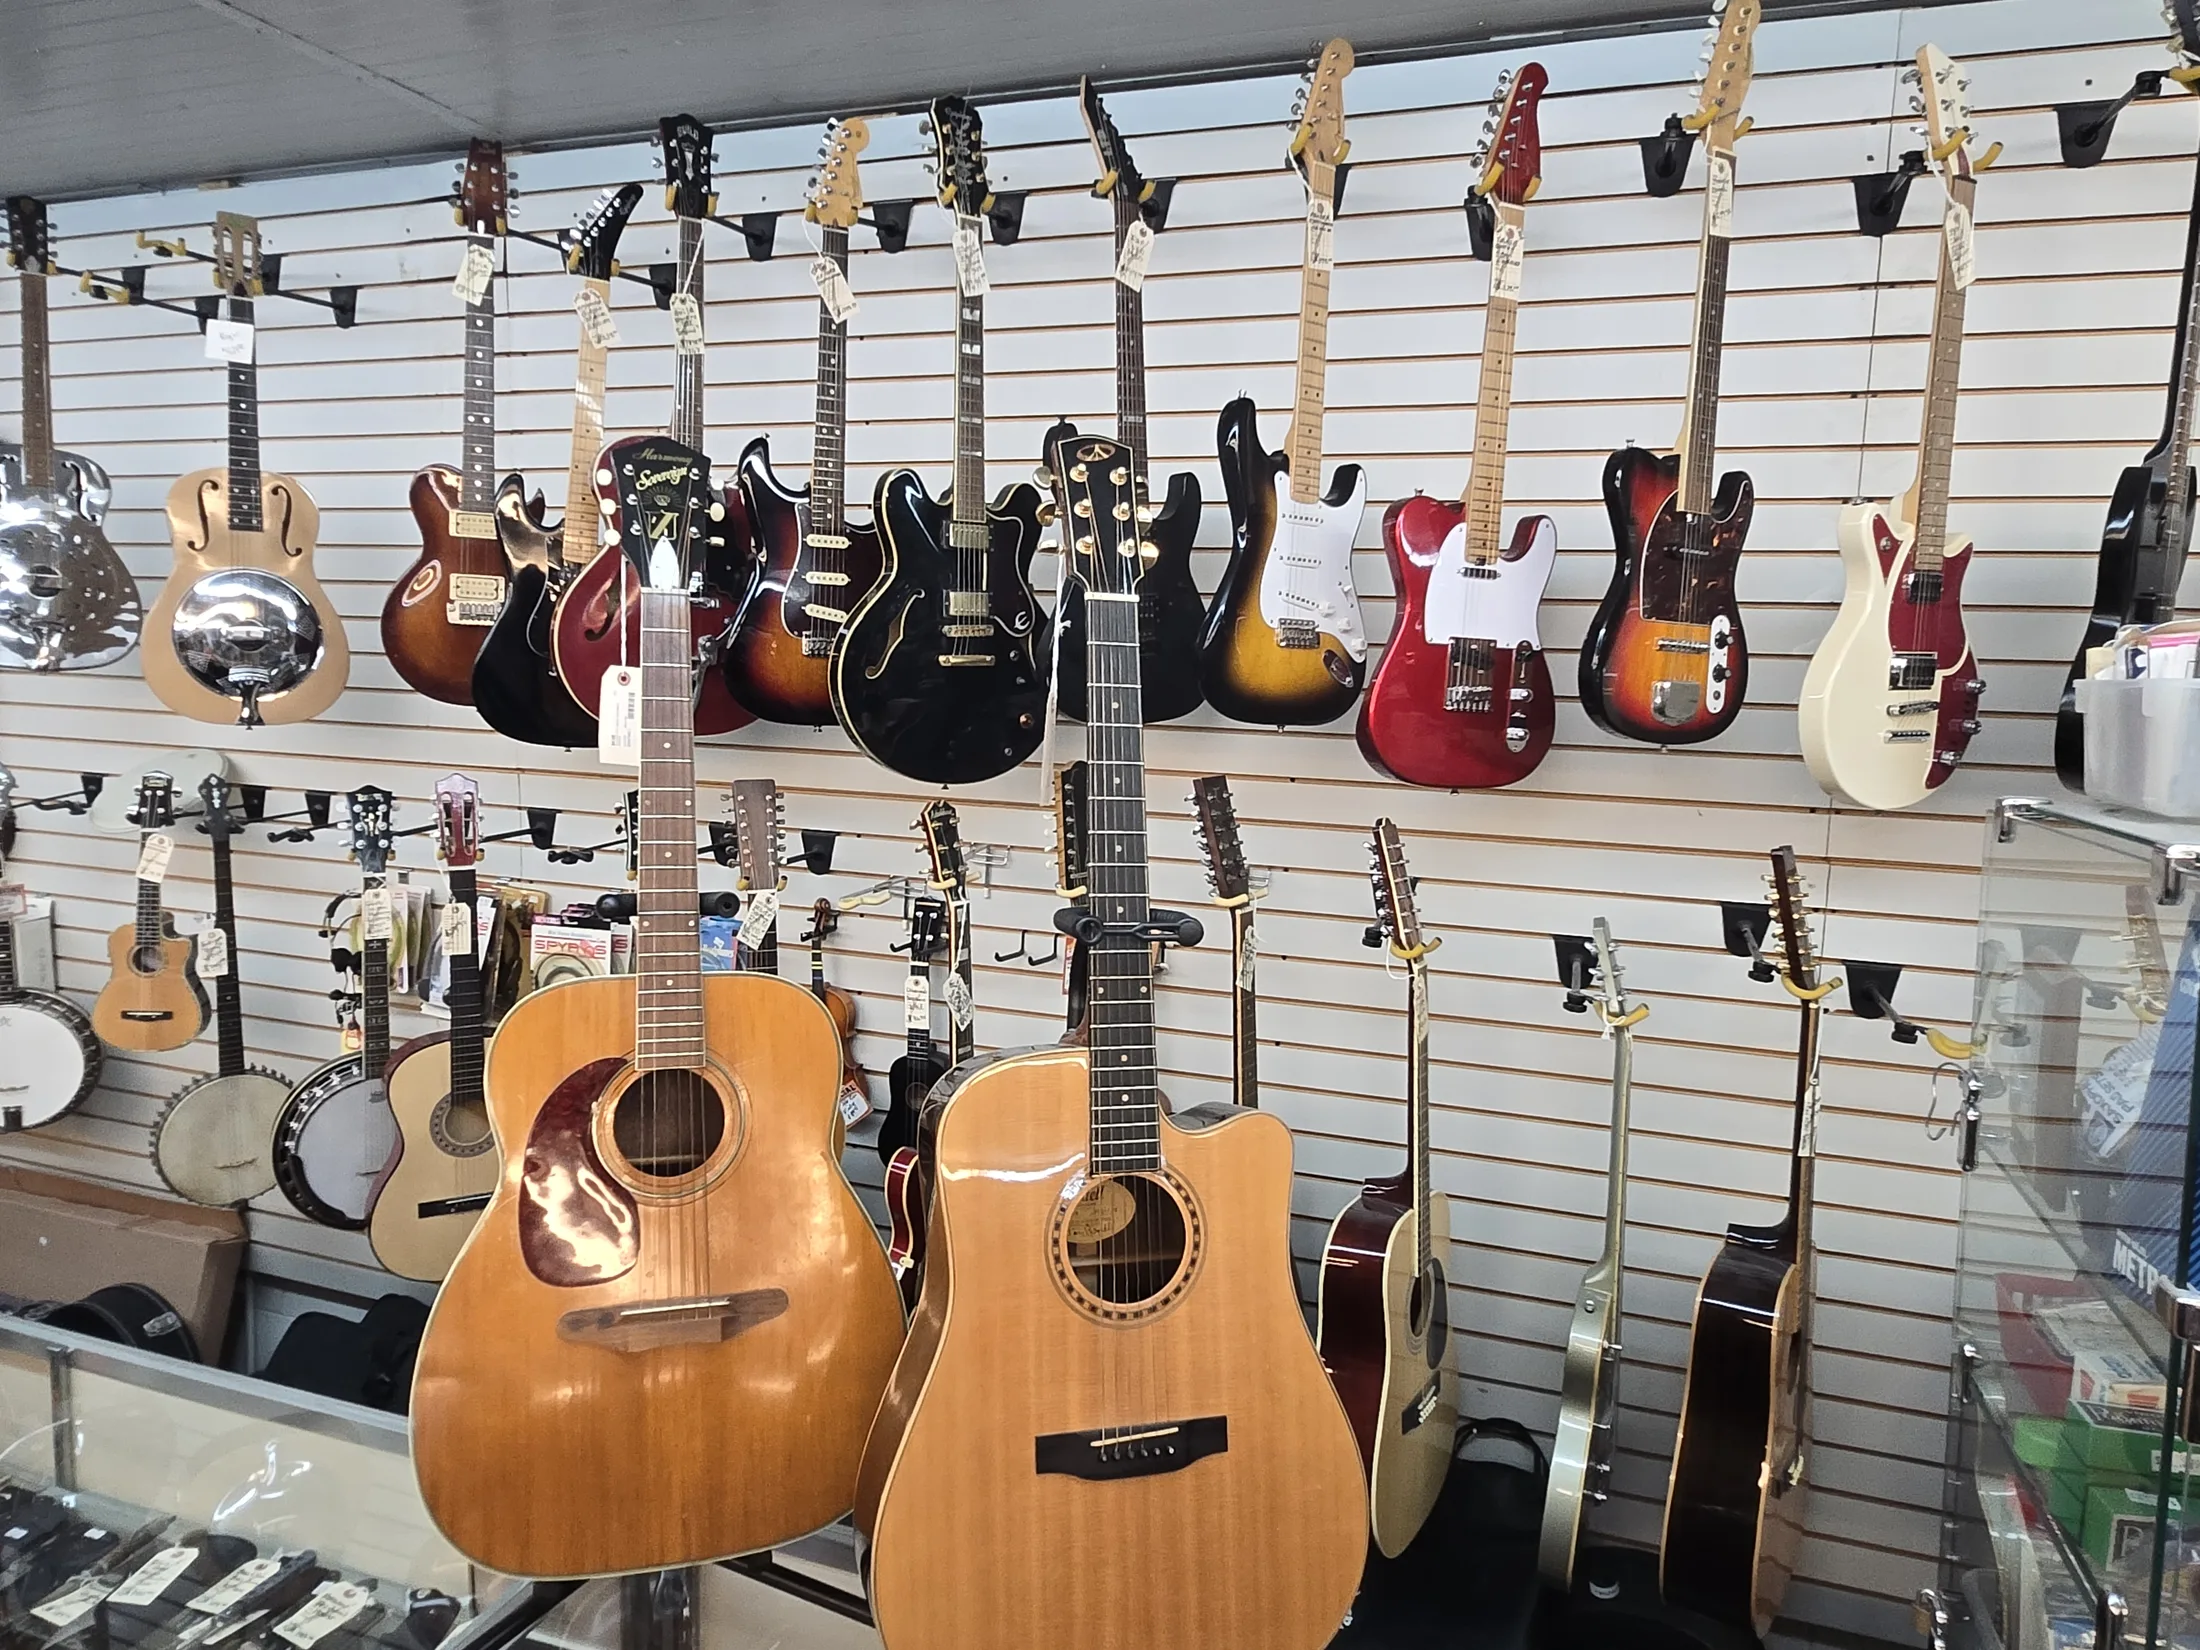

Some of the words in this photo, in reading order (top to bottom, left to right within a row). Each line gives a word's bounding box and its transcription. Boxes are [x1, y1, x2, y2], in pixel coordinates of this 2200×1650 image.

[677, 124, 699, 142] GUILD
[632, 447, 694, 467] Harmony
[636, 466, 690, 491] Sovereign
